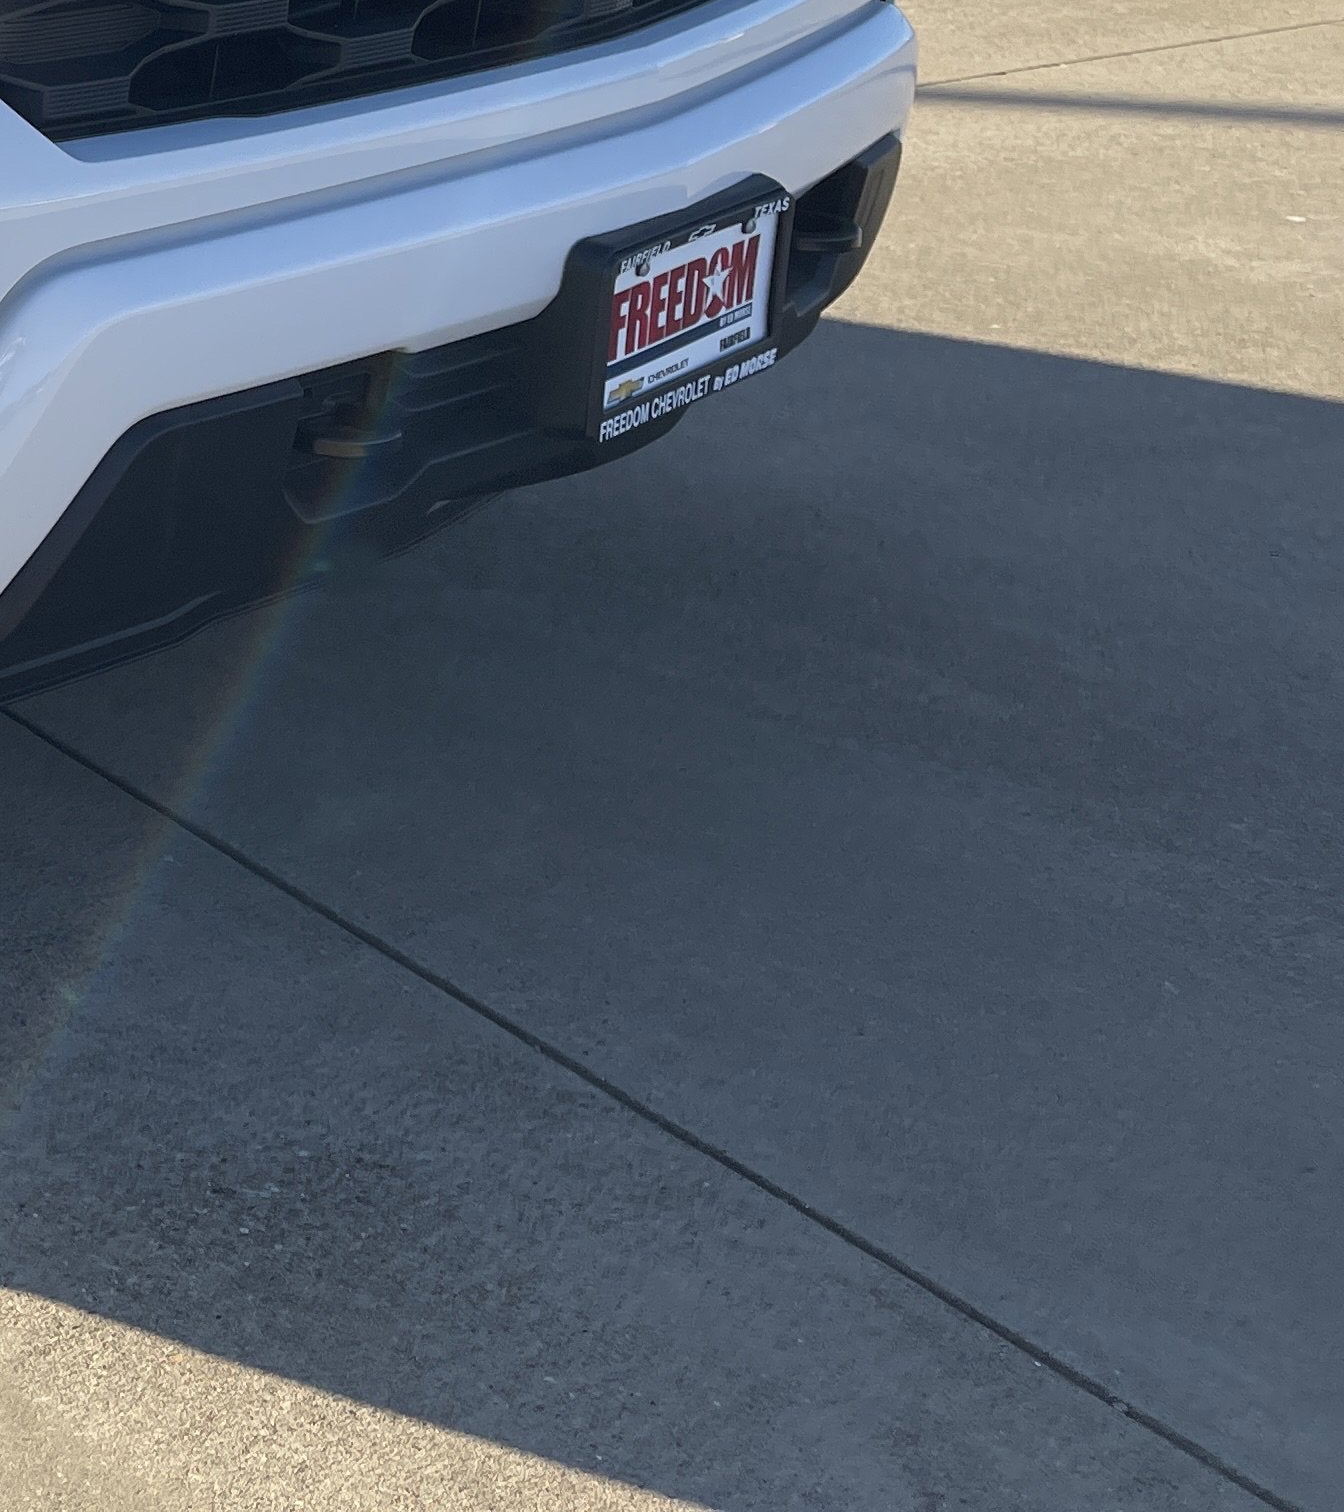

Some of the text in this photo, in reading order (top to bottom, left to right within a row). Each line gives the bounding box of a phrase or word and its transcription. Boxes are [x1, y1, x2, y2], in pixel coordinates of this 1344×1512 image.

[620, 196, 790, 274] FAIRFIELD TEXAS
[607, 233, 761, 363] FREEDOM
[599, 401, 650, 443] FREEDOM
[651, 374, 711, 419] CHEVROLET
[724, 364, 740, 387] ED
[739, 348, 778, 380] MORSE
[647, 357, 690, 385] CHEVROLET
